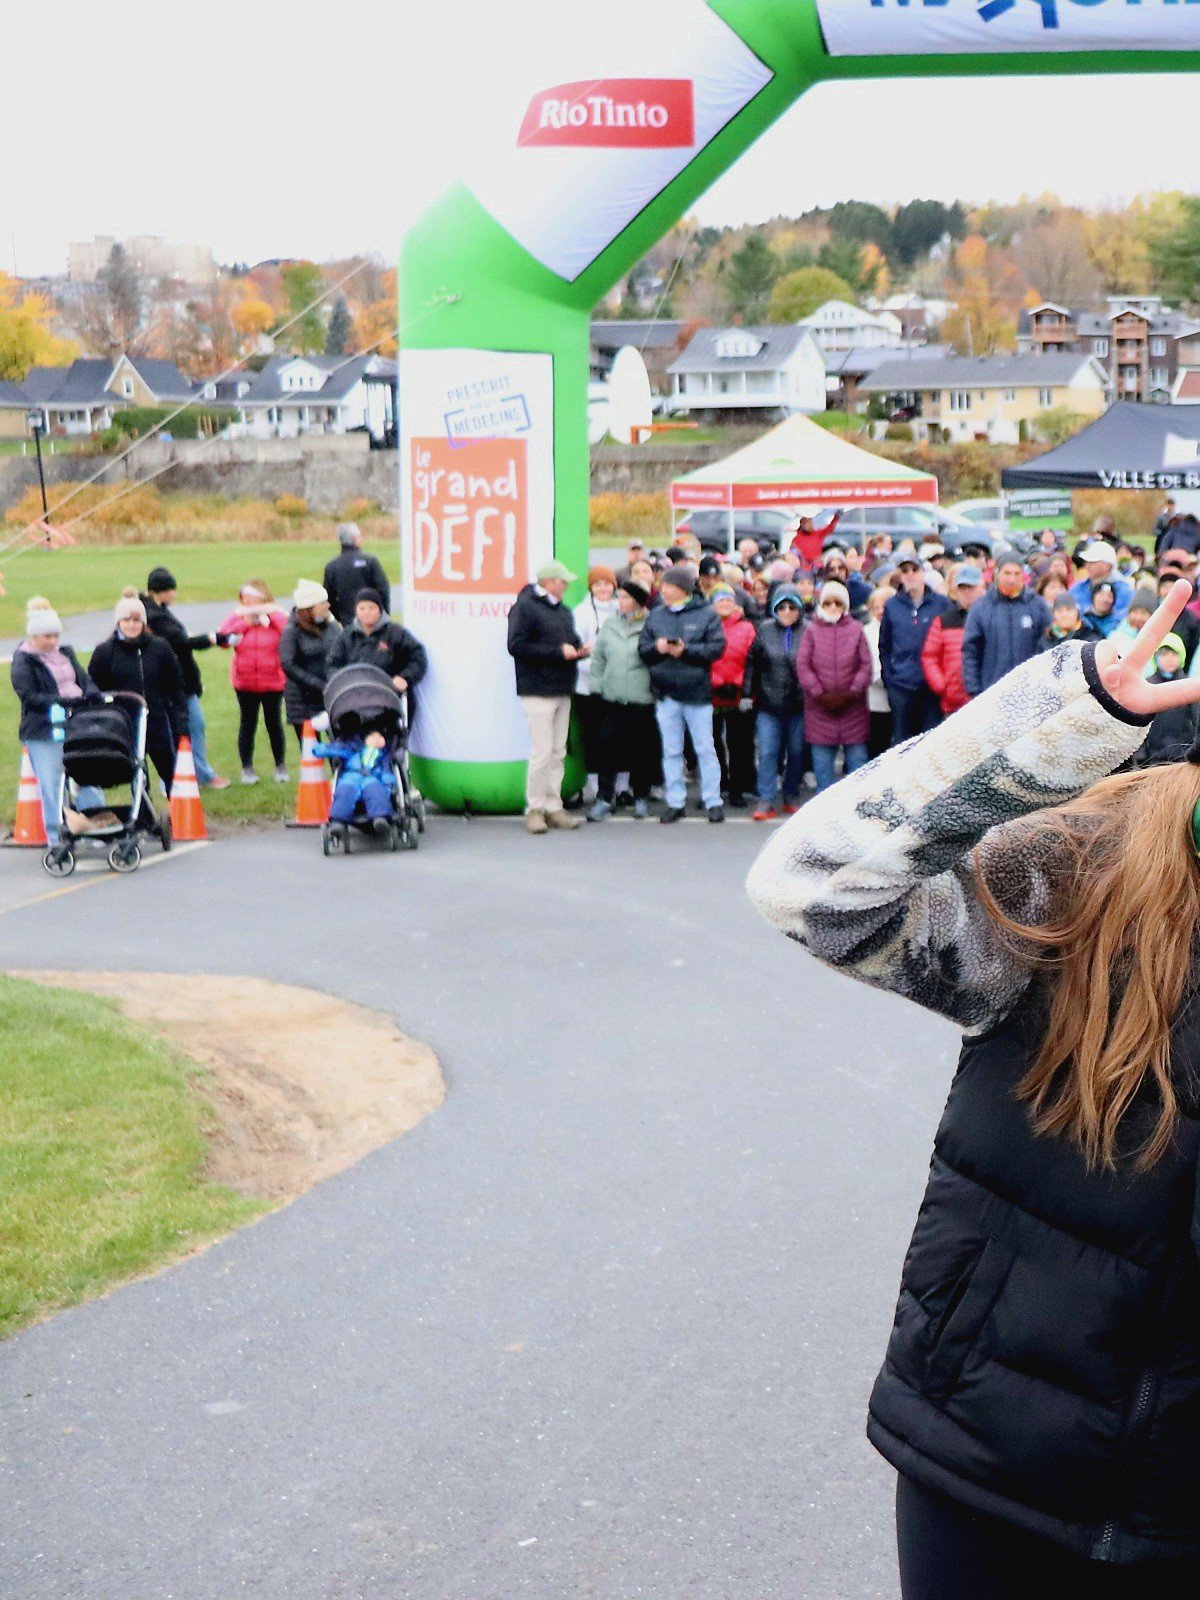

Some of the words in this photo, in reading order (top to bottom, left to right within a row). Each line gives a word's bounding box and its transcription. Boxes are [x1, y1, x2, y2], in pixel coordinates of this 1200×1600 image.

[447, 376, 511, 401] PRESCRIT
[416, 446, 431, 467] le
[414, 459, 518, 509] grand
[1098, 470, 1154, 488] VILLE
[414, 503, 517, 580] DÉFI
[412, 600, 457, 616] PIERRE
